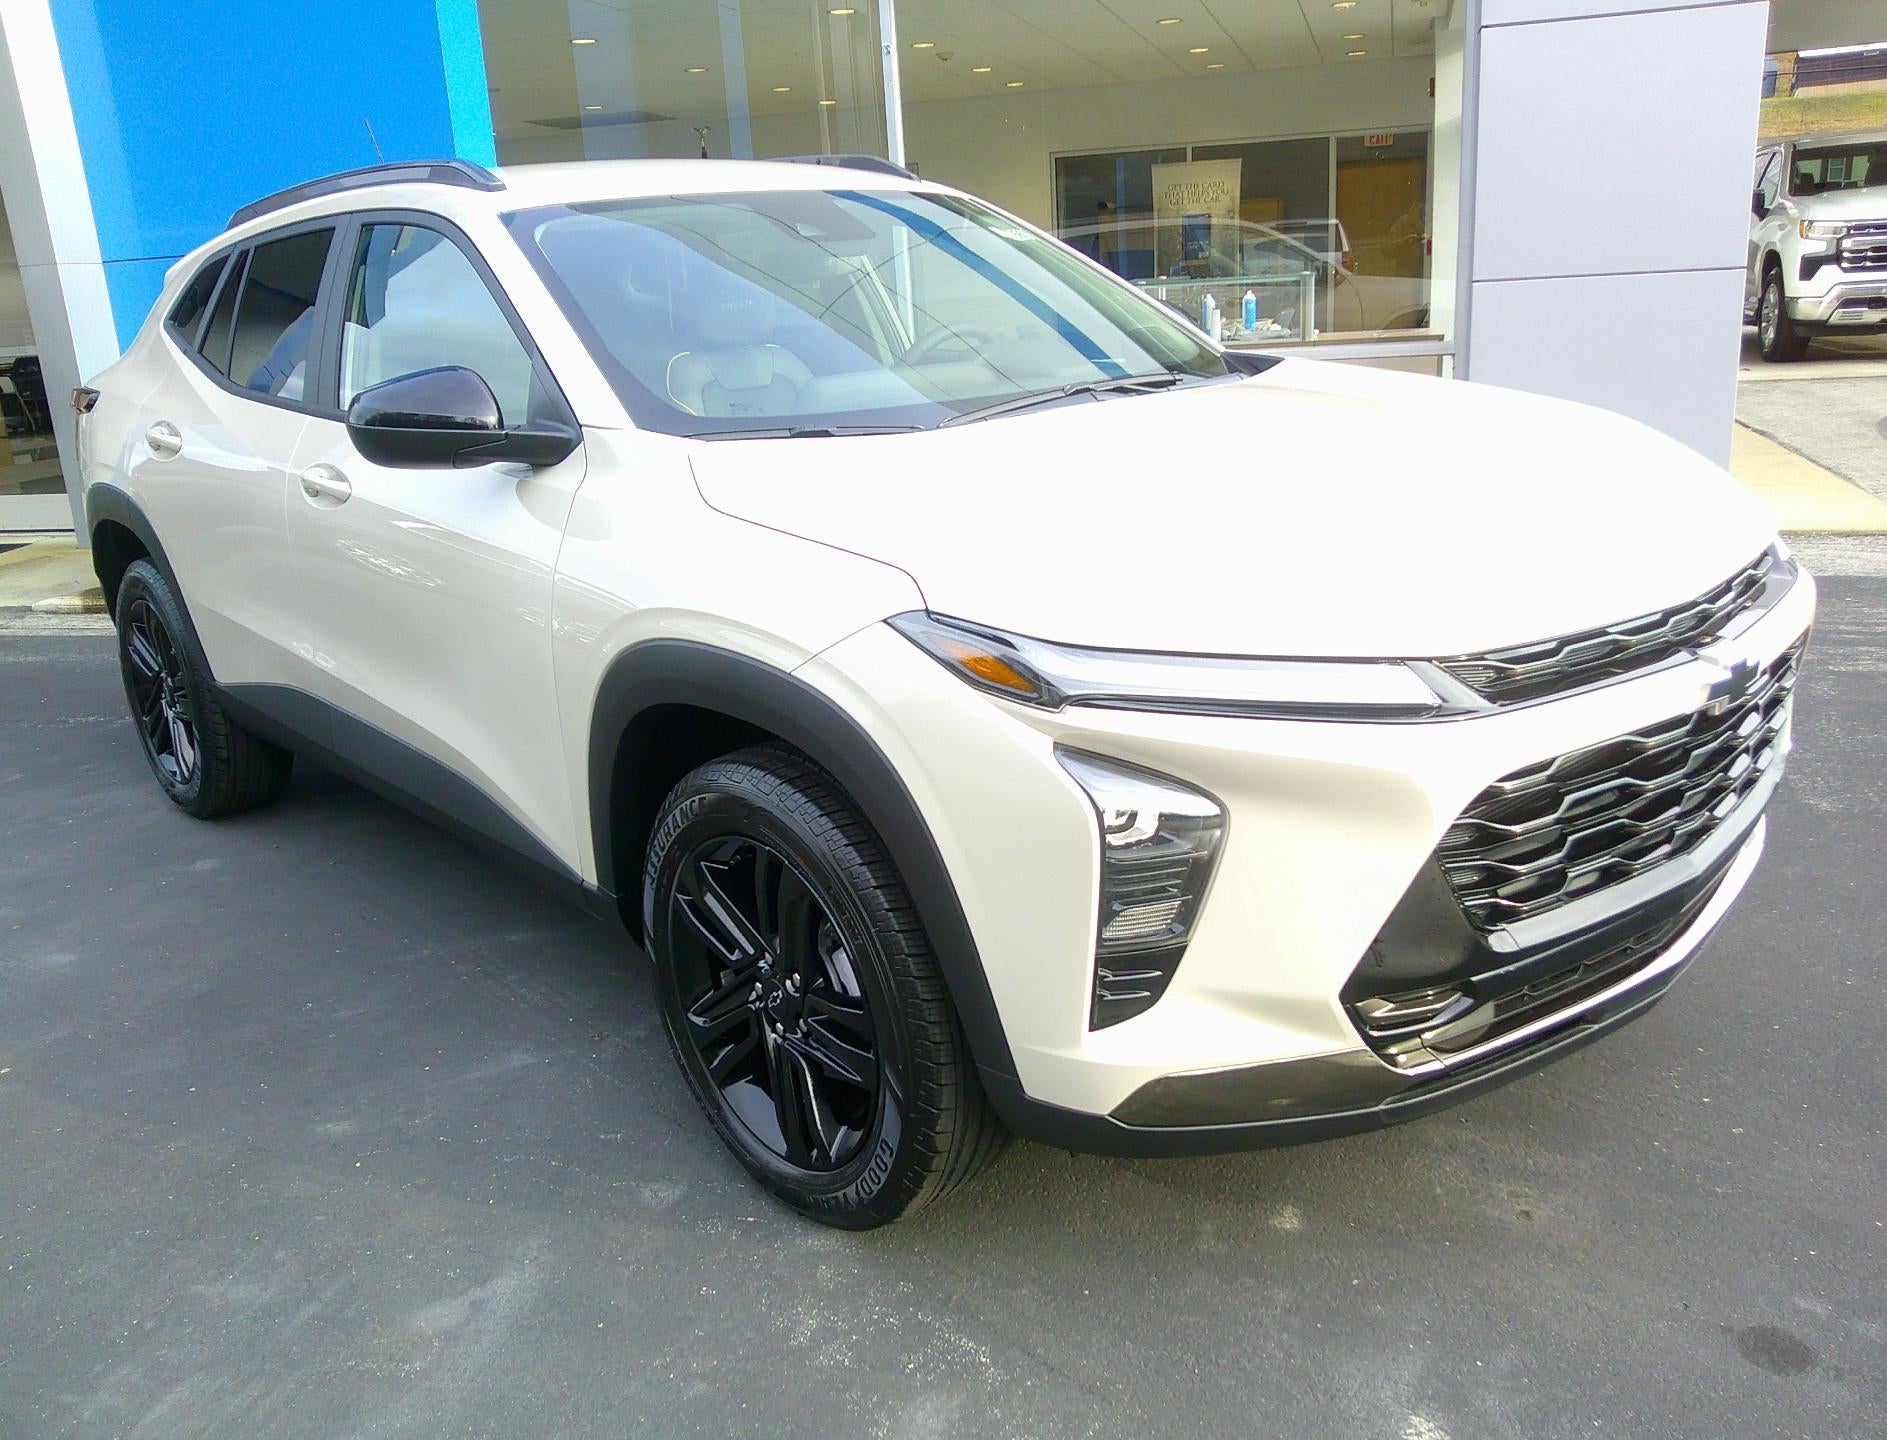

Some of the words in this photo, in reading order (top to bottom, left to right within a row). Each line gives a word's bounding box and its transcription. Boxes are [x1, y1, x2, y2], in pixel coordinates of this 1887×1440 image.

[1168, 184, 1182, 192] GET
[1185, 182, 1199, 191] THE
[1201, 181, 1225, 189] CARD
[1164, 191, 1185, 199] THAT
[1211, 187, 1229, 196] YOU
[1187, 197, 1201, 205] THE
